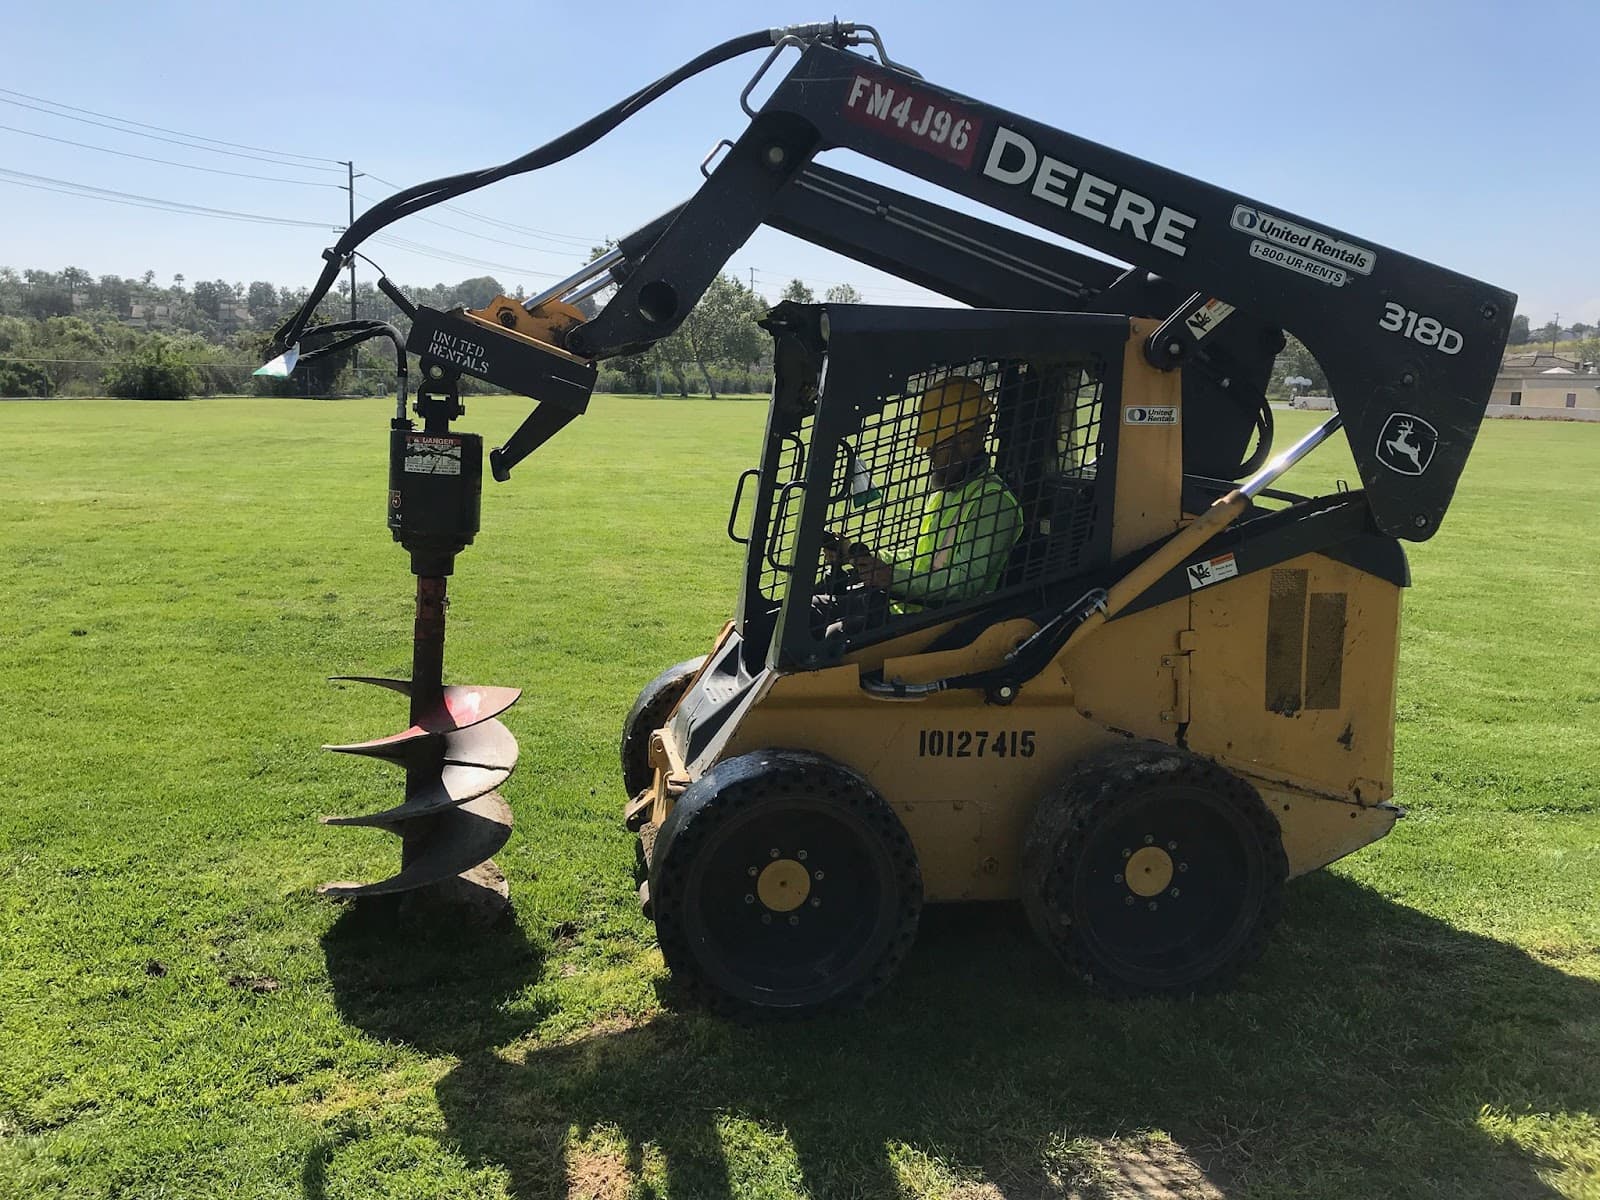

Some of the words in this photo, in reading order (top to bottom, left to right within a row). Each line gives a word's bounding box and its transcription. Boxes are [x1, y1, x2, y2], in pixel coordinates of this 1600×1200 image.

[847, 75, 973, 151] FM4J96
[982, 126, 1198, 257] DEERE
[1259, 218, 1312, 248] United
[1312, 238, 1367, 268] Rentals
[1253, 244, 1343, 283] 1-800-UR-RENTS
[432, 329, 485, 358] UNITED
[1378, 301, 1464, 355] 318D
[428, 342, 490, 374] RENTALS
[1148, 408, 1174, 416] United
[422, 437, 454, 445] DANGER
[919, 730, 1036, 758] 10127415
